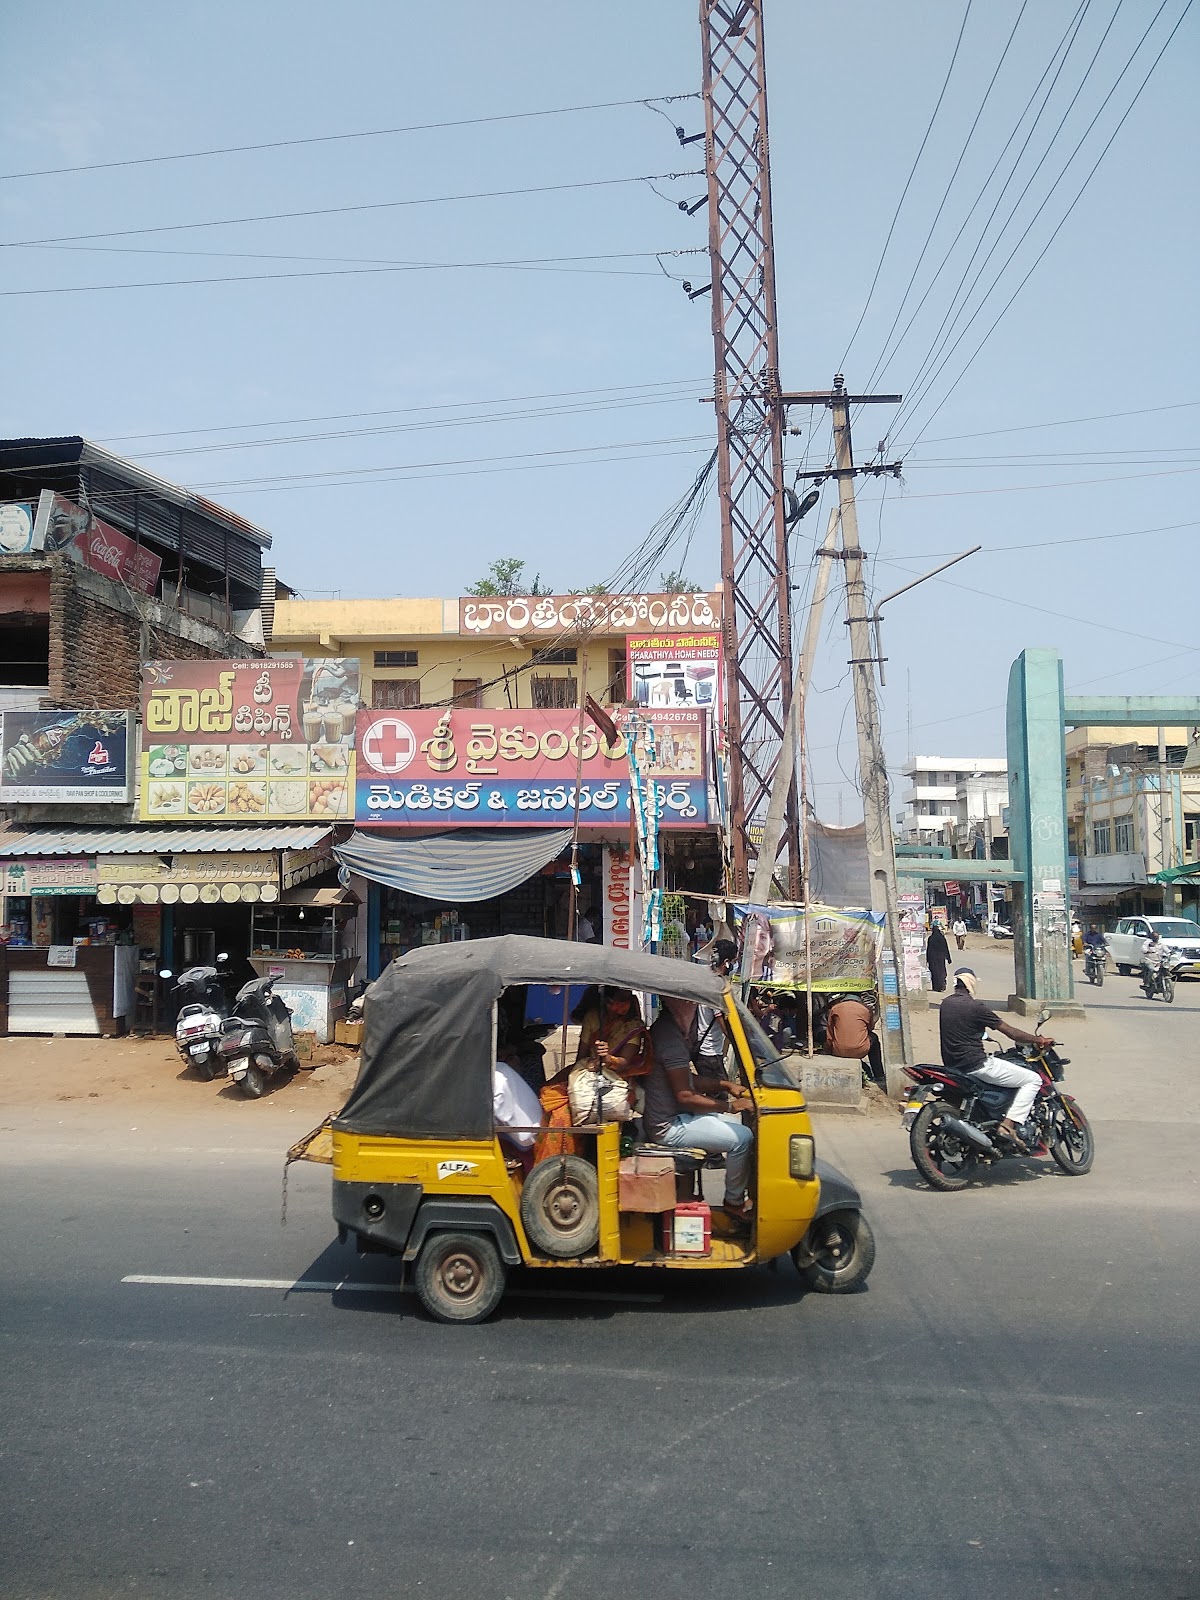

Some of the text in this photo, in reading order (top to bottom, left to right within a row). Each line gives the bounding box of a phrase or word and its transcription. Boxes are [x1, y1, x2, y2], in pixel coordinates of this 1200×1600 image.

[630, 649, 719, 660] BHARATHIYA HOME NEEDS
[232, 661, 294, 670] Cell: 9618291585
[253, 671, 272, 704] టీ
[147, 671, 236, 732] తాజ్
[640, 712, 699, 721] 49426788
[420, 716, 628, 774] శ్రీ వైకుంఠం
[366, 782, 482, 810] మెడికల్
[487, 791, 508, 810] &
[516, 782, 621, 810] జనరల్
[750, 826, 765, 835] HOM
[750, 835, 763, 844] NEED
[180, 867, 191, 879] &
[1033, 865, 1063, 878] VHP
[439, 1163, 471, 1172] ALFA
